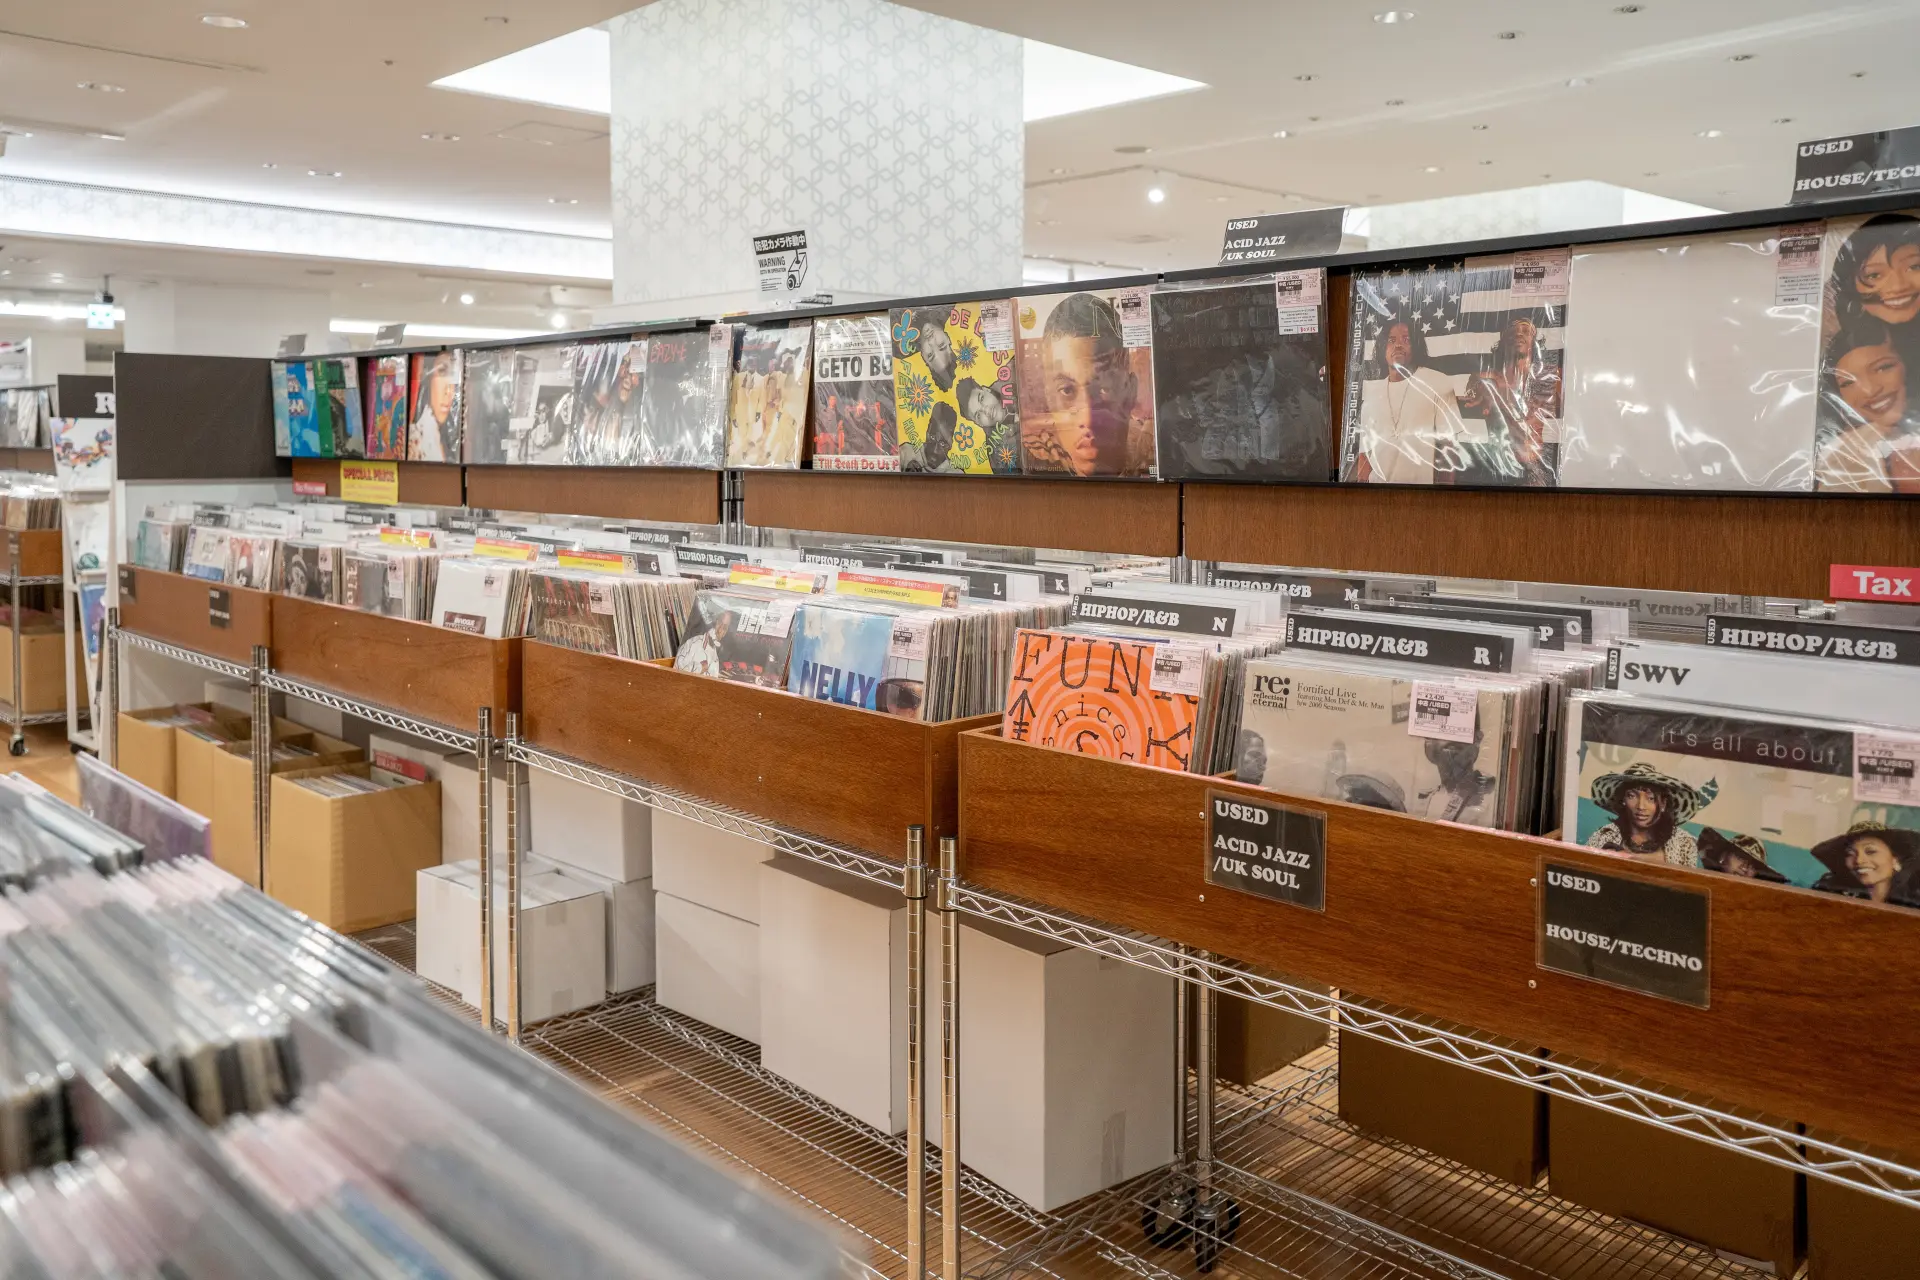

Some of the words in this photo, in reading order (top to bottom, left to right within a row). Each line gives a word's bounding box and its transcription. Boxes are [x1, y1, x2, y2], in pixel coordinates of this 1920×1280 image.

[1800, 140, 1853, 157] USED
[1228, 220, 1258, 230] USED
[754, 234, 805, 251] 防犯カメラ作動中
[1225, 239, 1253, 249] ACID
[1255, 236, 1286, 246] JAZZ
[758, 256, 786, 268] WARNING
[1220, 252, 1243, 262] /UK
[1246, 250, 1276, 259] SOUL
[950, 309, 971, 330] DE
[818, 356, 862, 378] GETO
[992, 350, 1014, 408] SOUL
[94, 392, 116, 414] R
[628, 532, 670, 543] HIPHOP/R&B
[678, 550, 726, 565] HIPHOP/R&B
[993, 582, 1002, 596] L
[1055, 578, 1066, 592] K
[1214, 578, 1312, 598] HIPHOP/R&B
[1344, 588, 1358, 602] M
[1853, 571, 1912, 596] Tax
[1080, 602, 1180, 626] HIPHOP/R&B
[1212, 616, 1228, 632] N
[1566, 620, 1582, 636] O
[1540, 624, 1554, 641] P
[1707, 618, 1716, 644] USED
[1720, 628, 1898, 661] HIPHOP/R&B
[1297, 627, 1428, 657] HIPHOP/R&B
[1473, 646, 1490, 666] R
[1608, 650, 1618, 680] USED
[1624, 662, 1691, 686] SWV
[799, 659, 876, 708] NELLY
[1254, 674, 1290, 696] re:
[1296, 683, 1334, 696] Fortified
[1336, 687, 1357, 699] Live
[1252, 698, 1288, 709] eternal
[1371, 702, 1385, 710] Man
[1660, 726, 1698, 747] it's
[1712, 735, 1741, 752] all
[1756, 740, 1834, 764] about
[1215, 800, 1268, 825] USED
[1214, 834, 1258, 856] ACID
[1262, 846, 1310, 869] JAZZ
[1213, 856, 1248, 876] /UK
[1252, 864, 1300, 890] SOUL
[1547, 871, 1600, 894] USED
[1546, 924, 1702, 972] HOUSE/TECHNO
